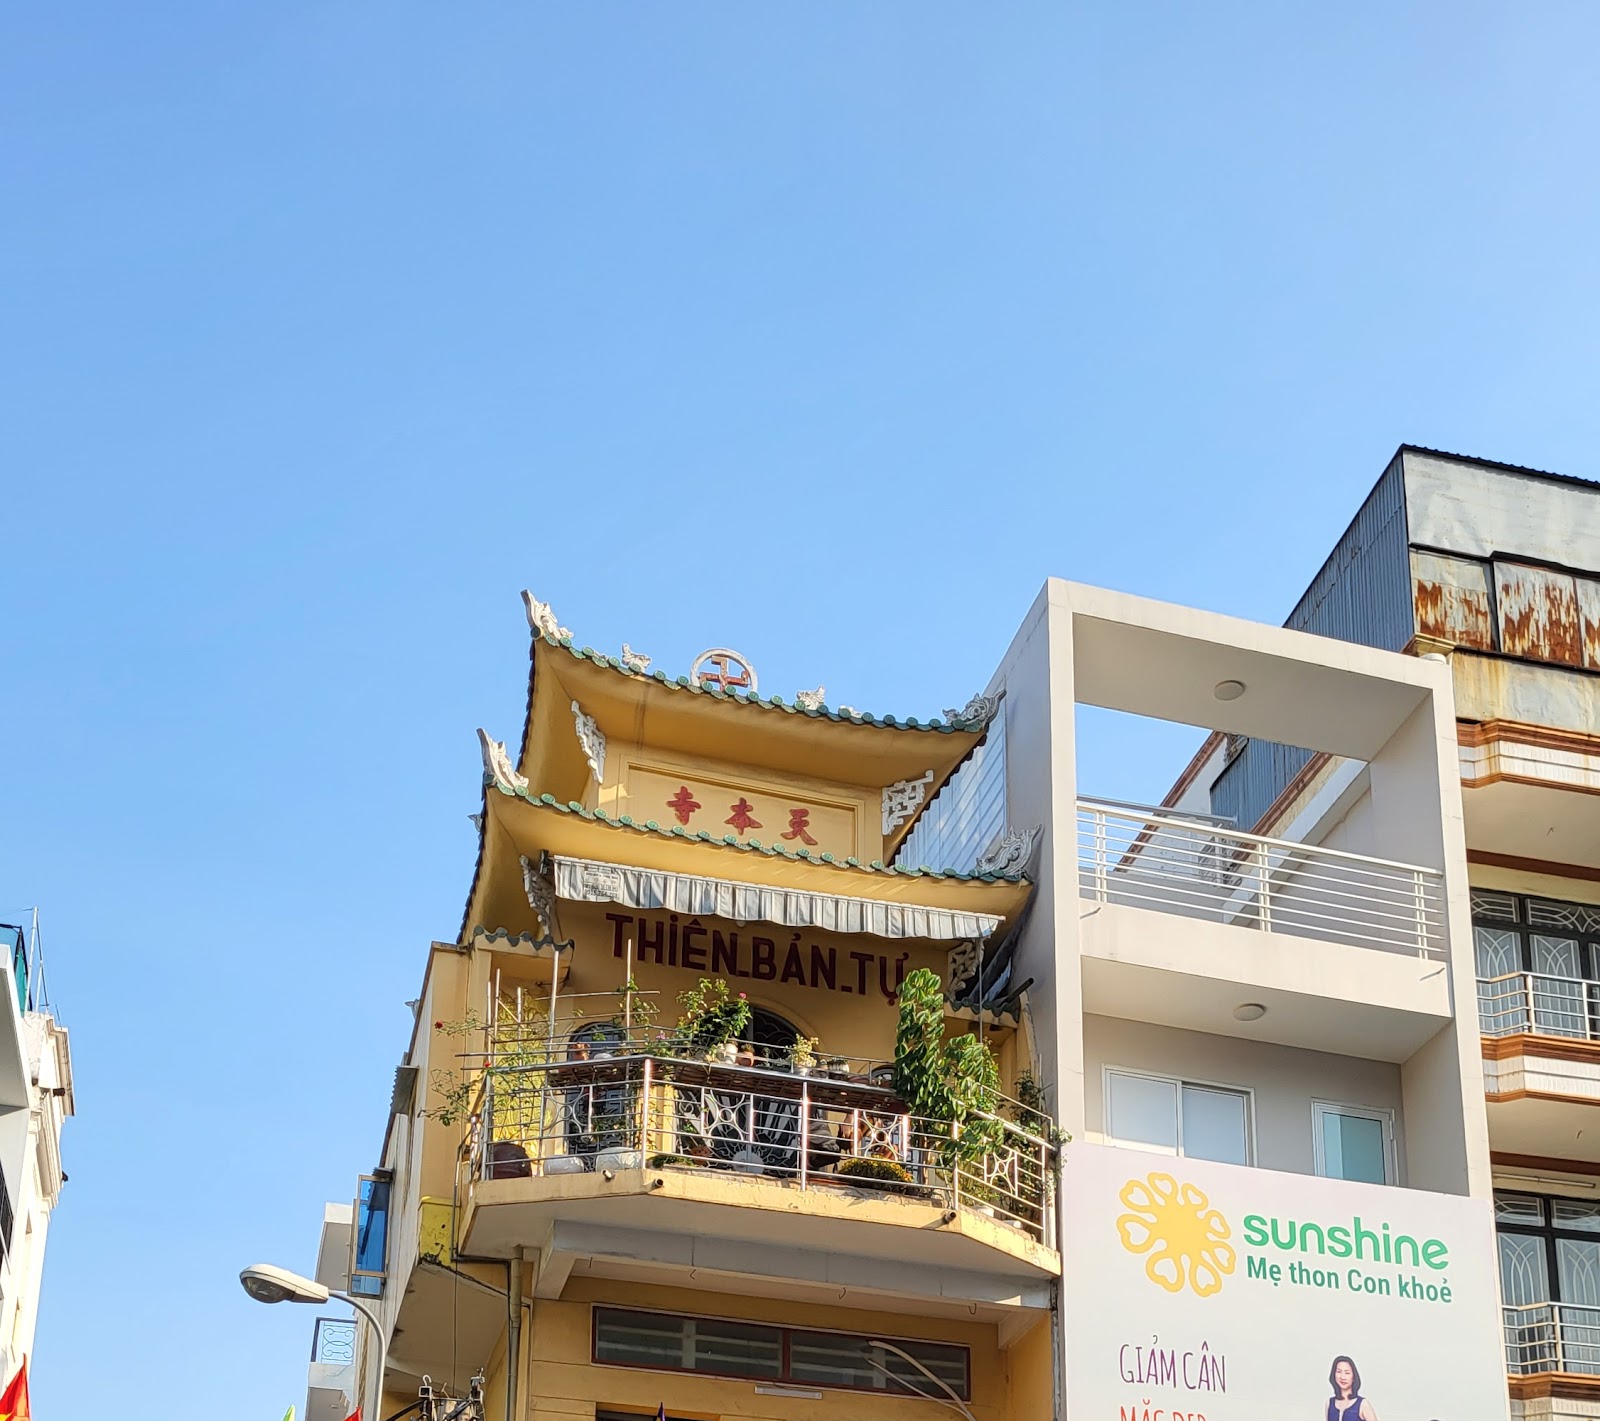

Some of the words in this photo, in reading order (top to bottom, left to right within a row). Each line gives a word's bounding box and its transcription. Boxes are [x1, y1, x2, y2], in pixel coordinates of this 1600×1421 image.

[1243, 1214, 1450, 1270] sunshine
[1246, 1255, 1282, 1287] Mẹ
[1289, 1261, 1340, 1289] thon
[1347, 1269, 1391, 1296] Con
[1119, 1334, 1177, 1389] GIẢM
[1182, 1340, 1227, 1394] CÂN
